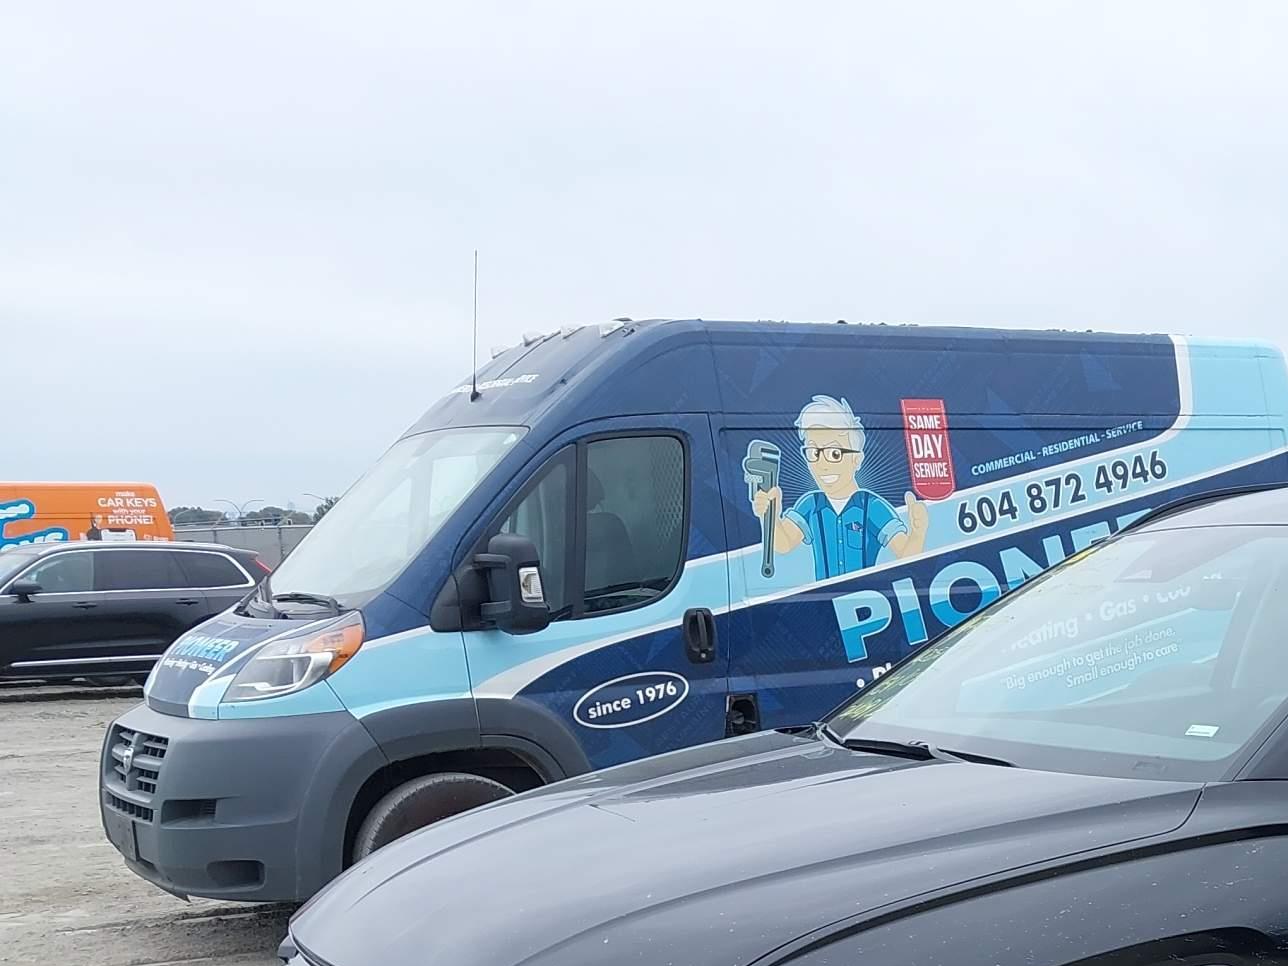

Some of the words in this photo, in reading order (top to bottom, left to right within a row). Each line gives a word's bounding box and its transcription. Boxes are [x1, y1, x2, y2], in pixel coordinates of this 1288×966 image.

[908, 414, 941, 430] SAME
[911, 434, 944, 459] DAY
[971, 450, 1036, 476] COMMERCIAL
[1041, 432, 1100, 457] RESIDENTIAL
[1105, 420, 1143, 439] SERVICE
[913, 461, 949, 479] SERVICE
[97, 497, 124, 508] CAR
[126, 497, 157, 508] KEYS
[957, 490, 1019, 534] 604
[1025, 472, 1087, 514] 872
[1093, 450, 1168, 495] 4946
[1099, 598, 1137, 622] Gas
[1027, 657, 1071, 683] enough
[1072, 655, 1084, 667] to
[1085, 647, 1104, 667] get
[1105, 640, 1122, 657] the
[1124, 634, 1143, 656] job
[1065, 665, 1098, 688] Small
[1100, 651, 1142, 676] enough
[1142, 651, 1154, 662] to
[587, 697, 632, 719] since
[635, 681, 677, 705] 1976
